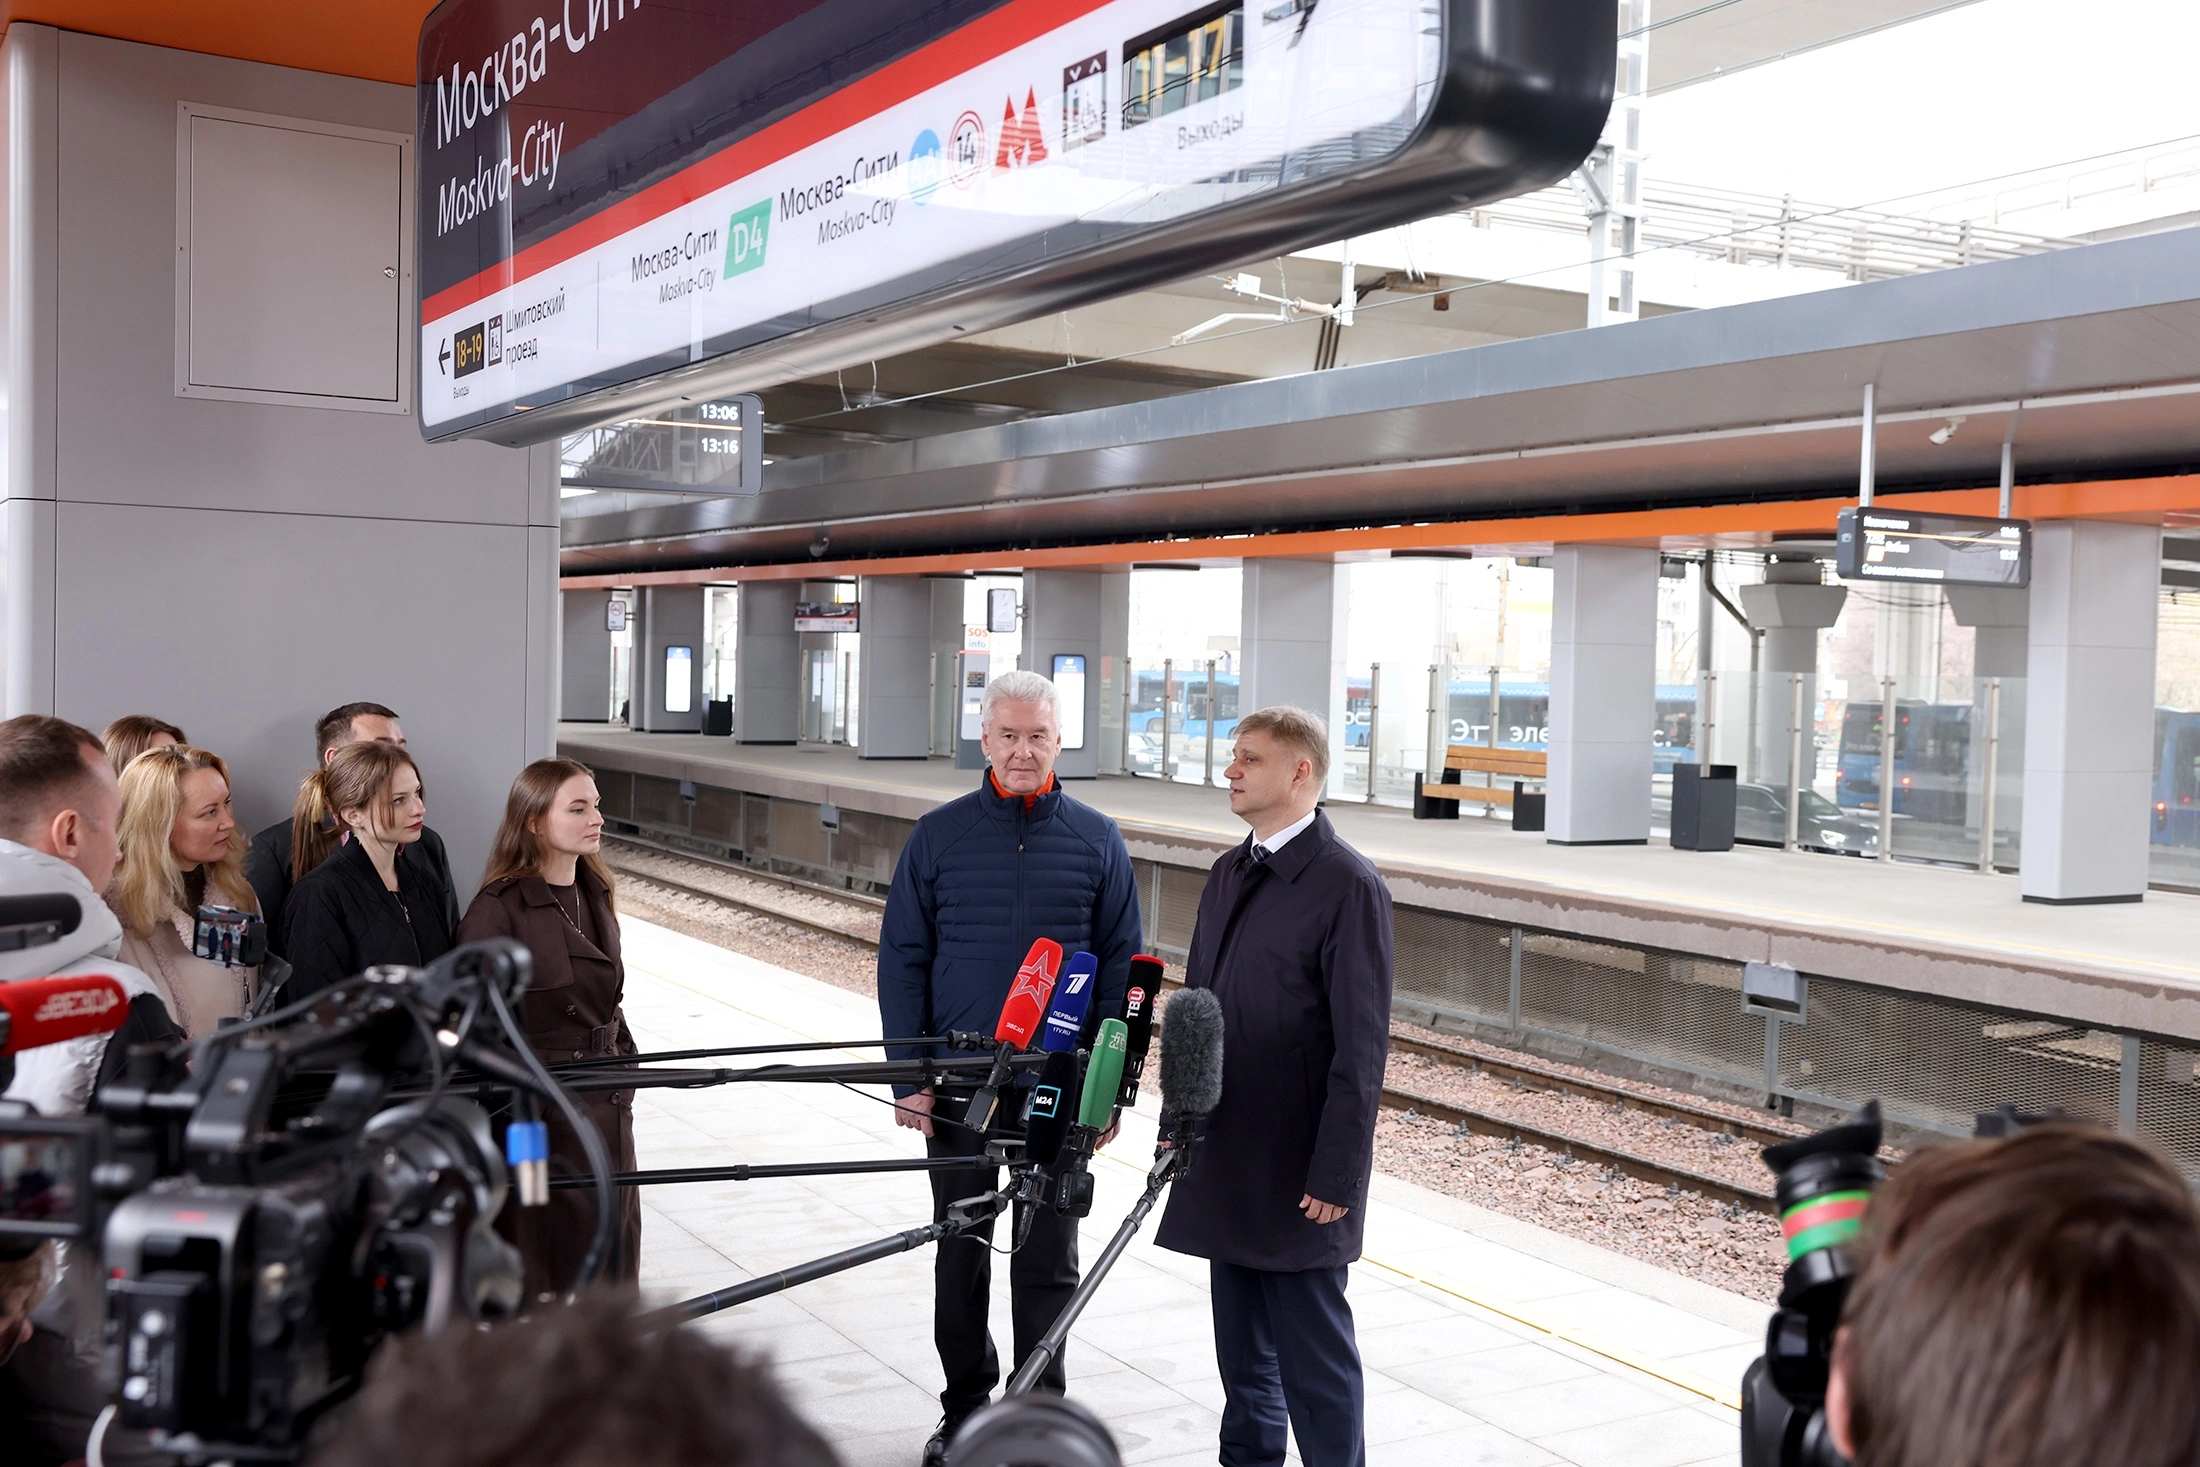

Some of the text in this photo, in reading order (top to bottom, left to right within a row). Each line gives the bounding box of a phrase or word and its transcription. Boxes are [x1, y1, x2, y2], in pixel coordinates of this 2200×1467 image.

[437, 0, 643, 150] Москва-Си
[1178, 114, 1244, 149] Выходы
[956, 131, 977, 170] 14
[438, 120, 565, 237] Moskva-City
[780, 150, 899, 222] Москва-Сити
[818, 197, 898, 246] Moskva-City
[631, 228, 717, 283] Москва-Сити
[732, 215, 764, 265] D4
[658, 267, 717, 304] Moskva-City
[506, 286, 565, 333] Шмитовский
[456, 332, 483, 369] 18-19
[505, 338, 538, 370] проезд
[701, 403, 739, 420] 13:06
[701, 437, 739, 454] 13:16
[968, 627, 988, 638] SOS
[968, 640, 987, 649] info
[1451, 718, 1490, 742] Эт
[1052, 1010, 1079, 1023] ПЕРВЫЙ
[1126, 987, 1145, 1018] ТВЦ
[1052, 1026, 1072, 1036] 1TV.RU
[1035, 1095, 1054, 1107] М24
